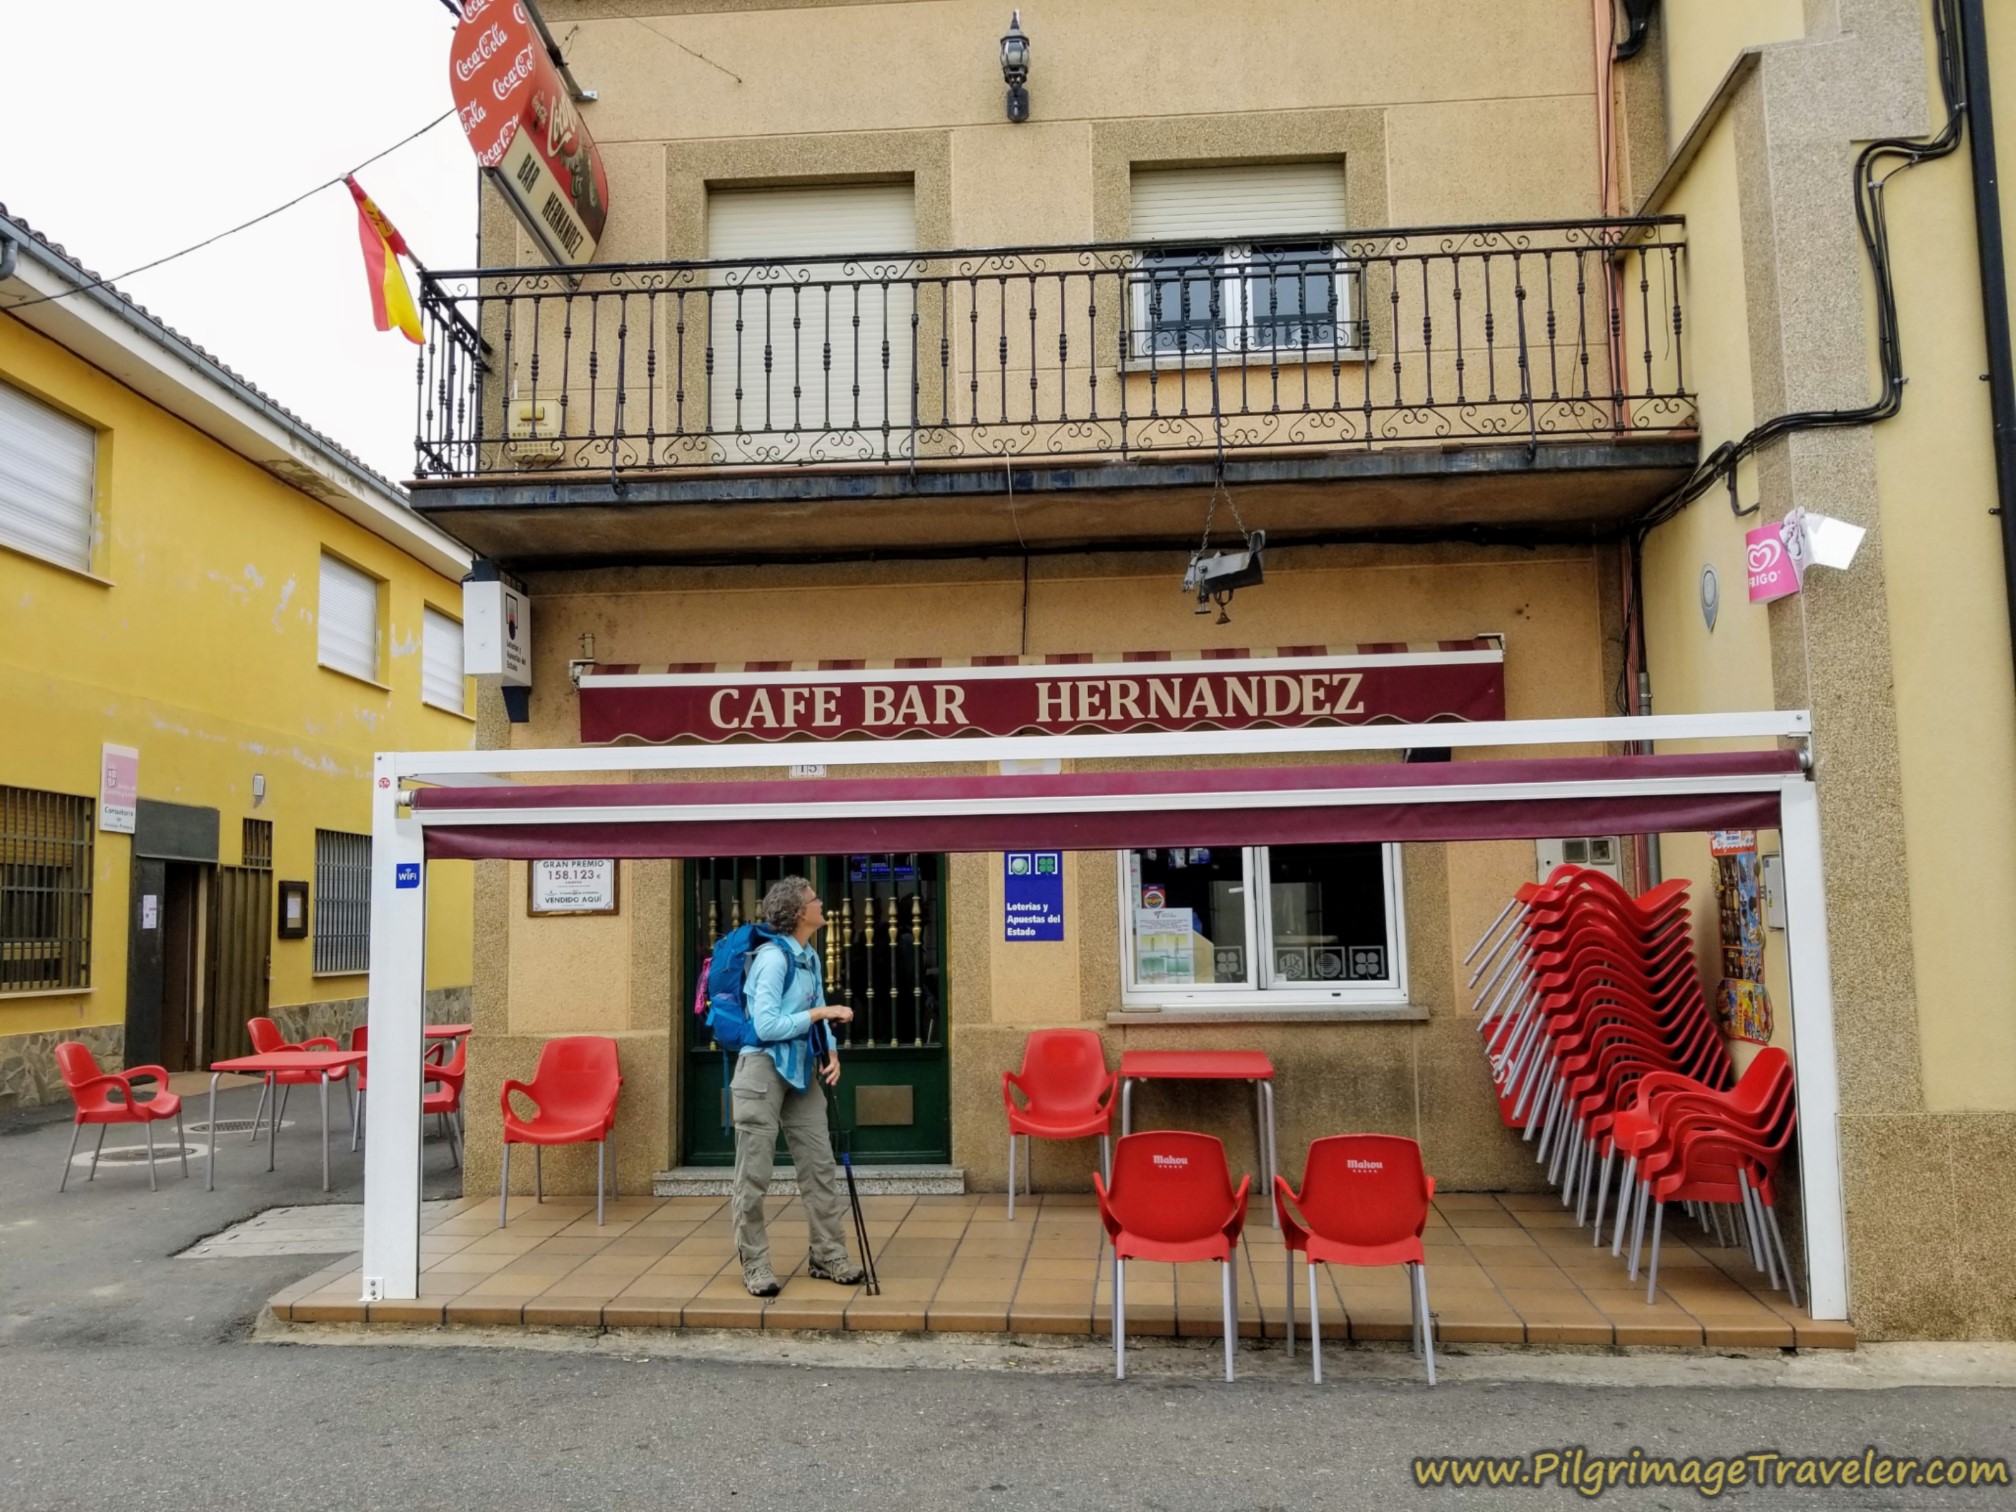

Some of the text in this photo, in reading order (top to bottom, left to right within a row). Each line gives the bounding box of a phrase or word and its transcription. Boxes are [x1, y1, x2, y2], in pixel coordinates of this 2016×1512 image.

[456, 21, 508, 82] Coca-Cola
[517, 153, 540, 195] BAR
[541, 191, 584, 260] HERNANDEZ
[709, 673, 1365, 729] CAFE BAR HERNANDEZ
[548, 870, 594, 880] 158.123
[1043, 903, 1048, 912] y
[1006, 914, 1060, 925] Apuestas del
[1007, 927, 1036, 936] Estado
[1153, 1155, 1188, 1165] Mahou
[1347, 1159, 1383, 1169] Mahou
